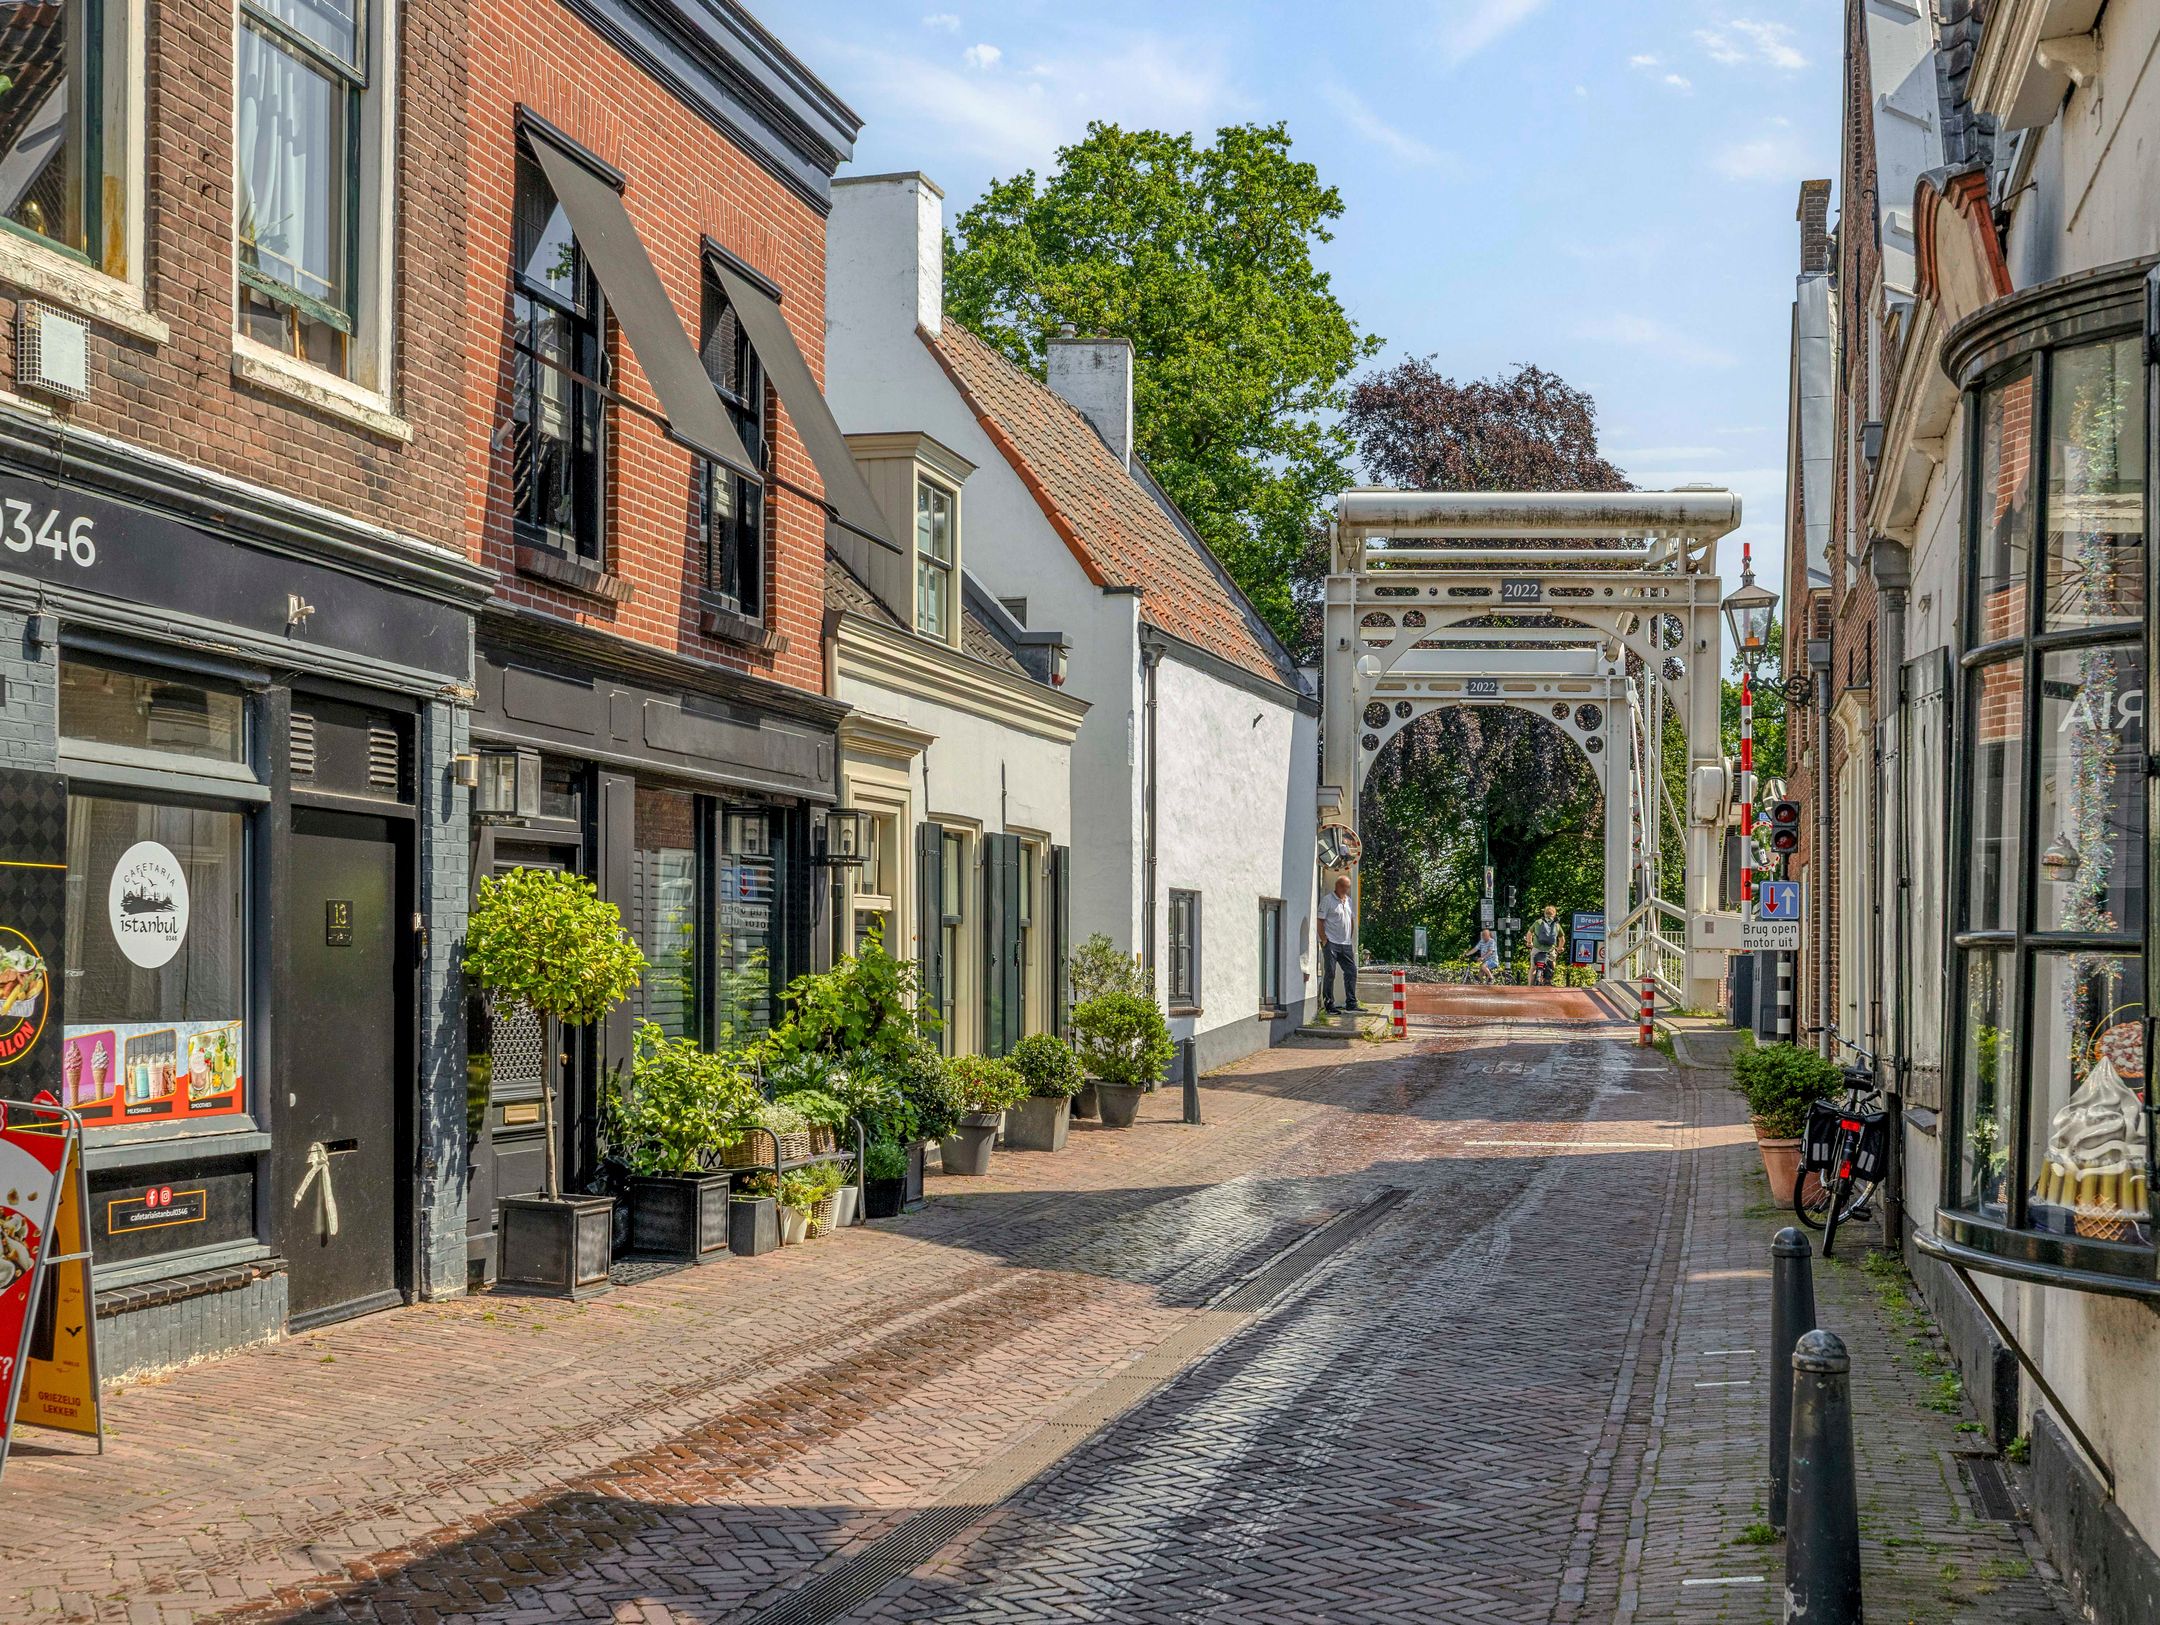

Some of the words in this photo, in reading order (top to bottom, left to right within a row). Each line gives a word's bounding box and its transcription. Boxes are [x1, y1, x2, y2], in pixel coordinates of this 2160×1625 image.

[0, 498, 96, 568] 346
[1504, 584, 1539, 597] 2022
[1470, 682, 1496, 692] 2022
[123, 862, 176, 888] CAFETARIA
[334, 903, 347, 924] 13
[120, 914, 179, 934] istanbul
[1743, 923, 1768, 937] Brug
[1771, 925, 1797, 936] open
[165, 934, 178, 942] 0346
[1743, 937, 1776, 948] motor
[1778, 936, 1793, 948] uit
[126, 1106, 152, 1114] MILKSHAKES
[130, 1207, 188, 1222] cafetariaistanbul0346
[38, 1391, 81, 1407] GRIEZELIG
[43, 1404, 78, 1418] LEKKER!
